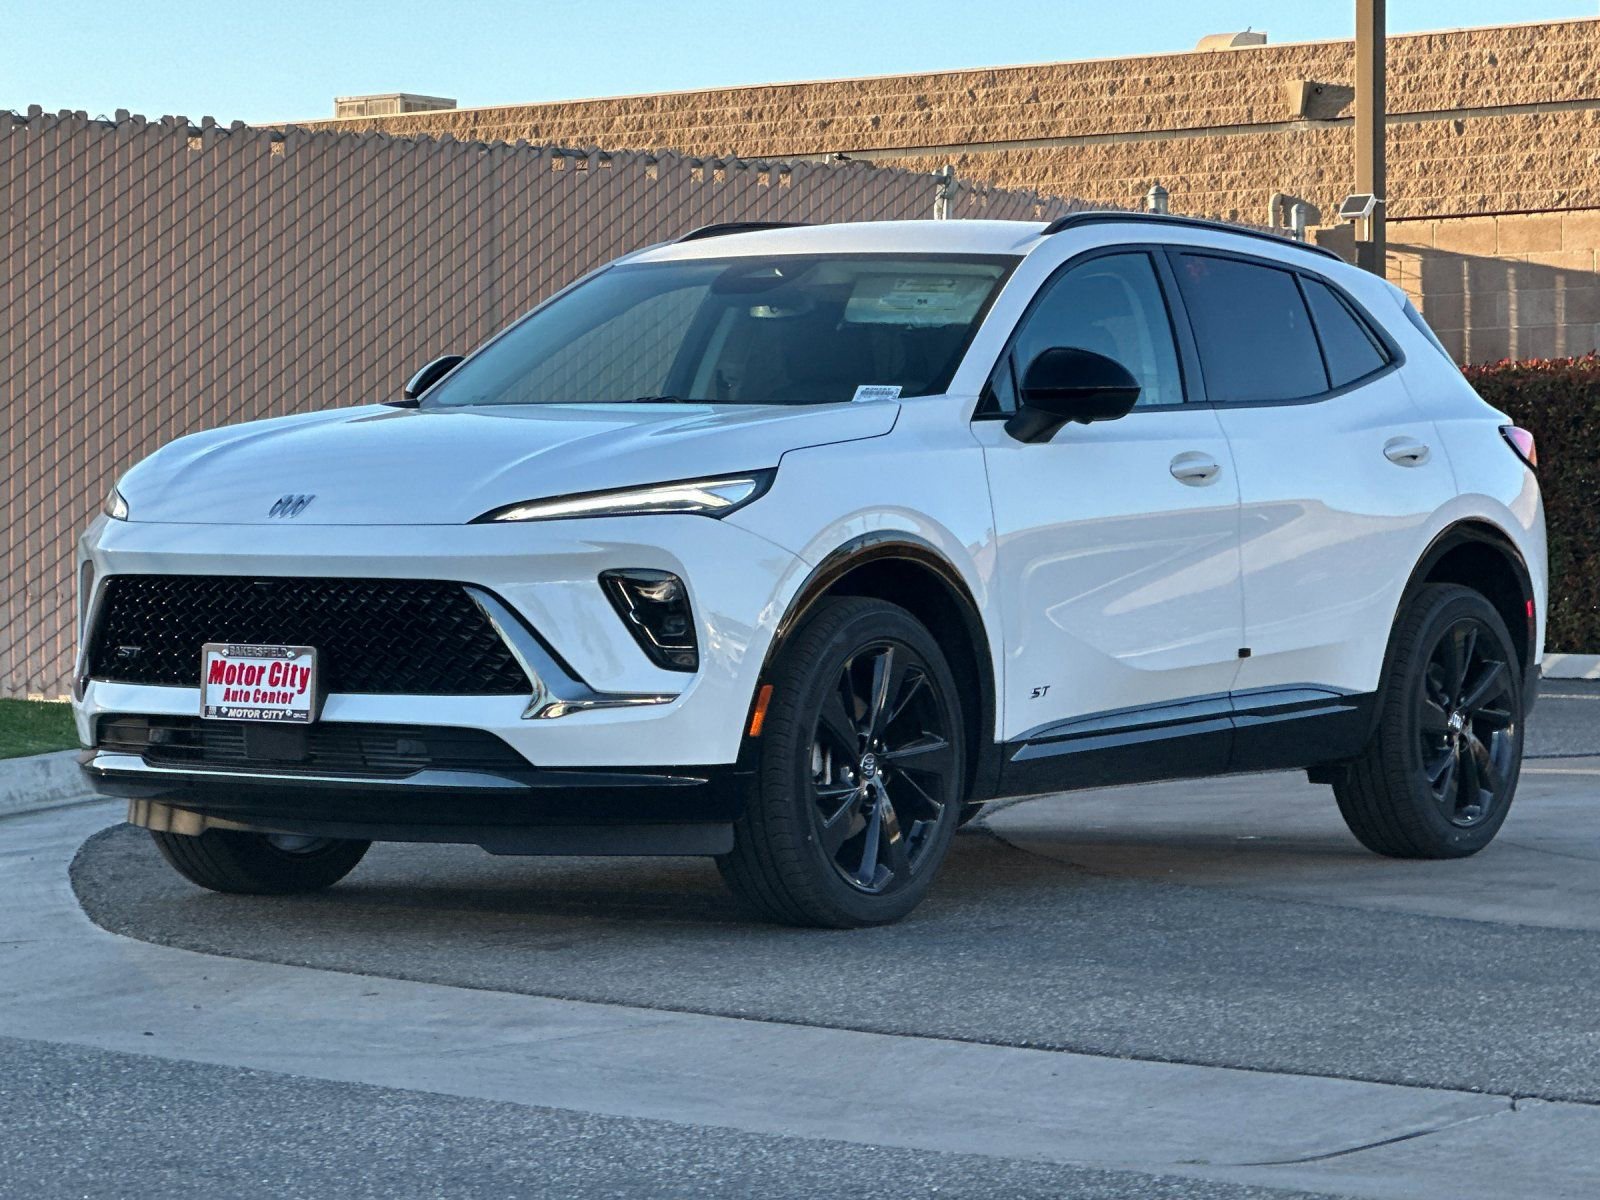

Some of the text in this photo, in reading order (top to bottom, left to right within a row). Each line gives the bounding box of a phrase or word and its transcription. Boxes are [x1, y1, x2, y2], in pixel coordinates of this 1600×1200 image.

[229, 645, 288, 657] BAKERSFIELD
[208, 660, 311, 694] Motor City
[223, 687, 295, 704] Auto Center
[1030, 685, 1051, 699] ST
[228, 708, 260, 719] MOTOR
[262, 710, 284, 720] CITY
